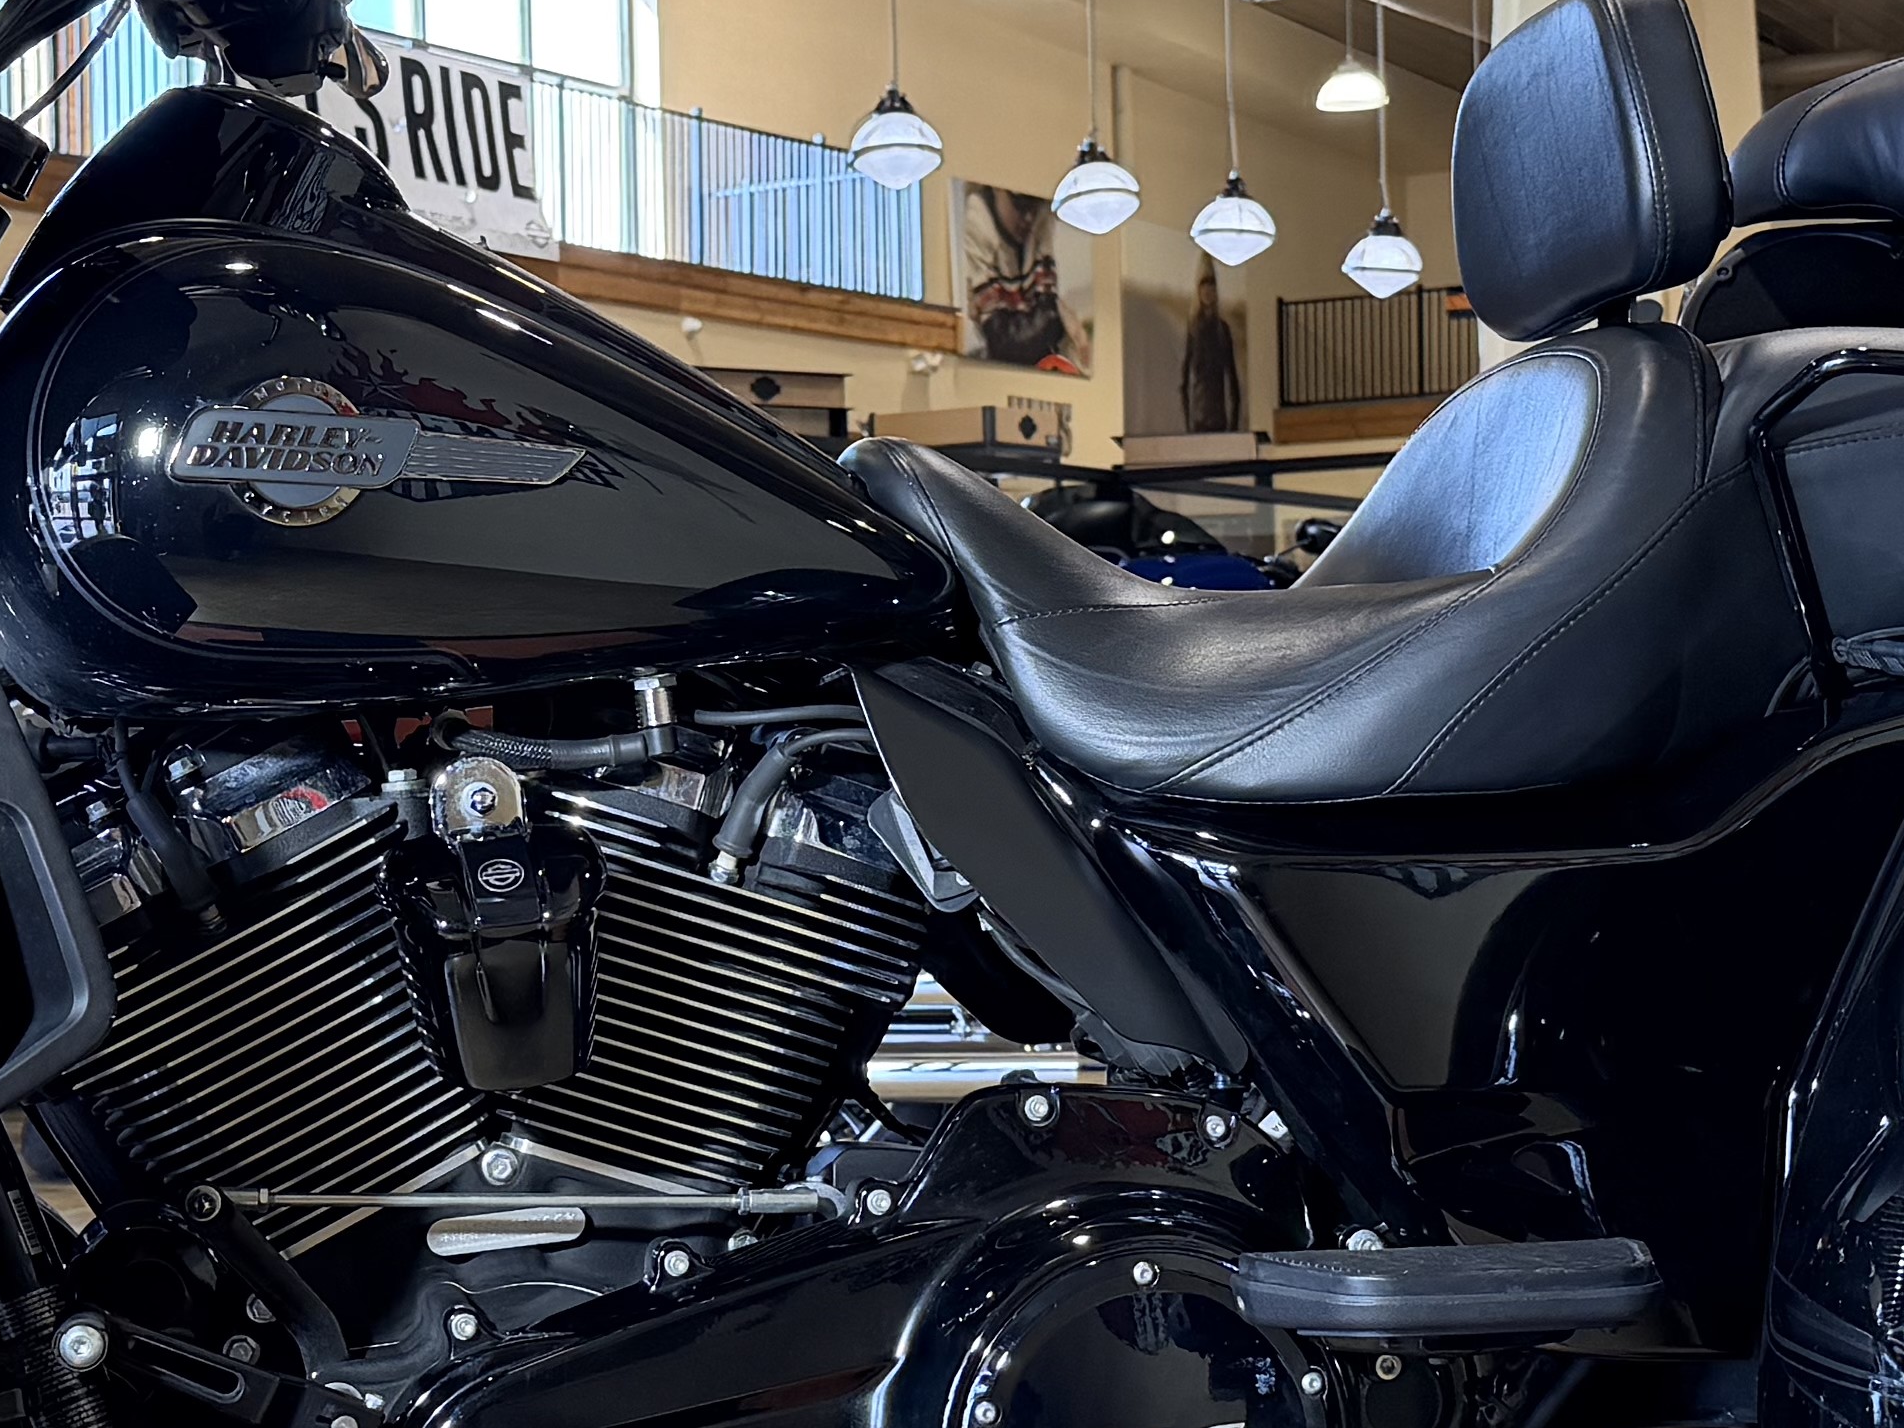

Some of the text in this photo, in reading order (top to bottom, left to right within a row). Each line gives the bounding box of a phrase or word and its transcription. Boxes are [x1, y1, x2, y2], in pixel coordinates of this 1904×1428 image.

[399, 55, 538, 204] RIDE
[207, 420, 384, 451] HARLEY-
[185, 443, 387, 477] DAVIDSON
